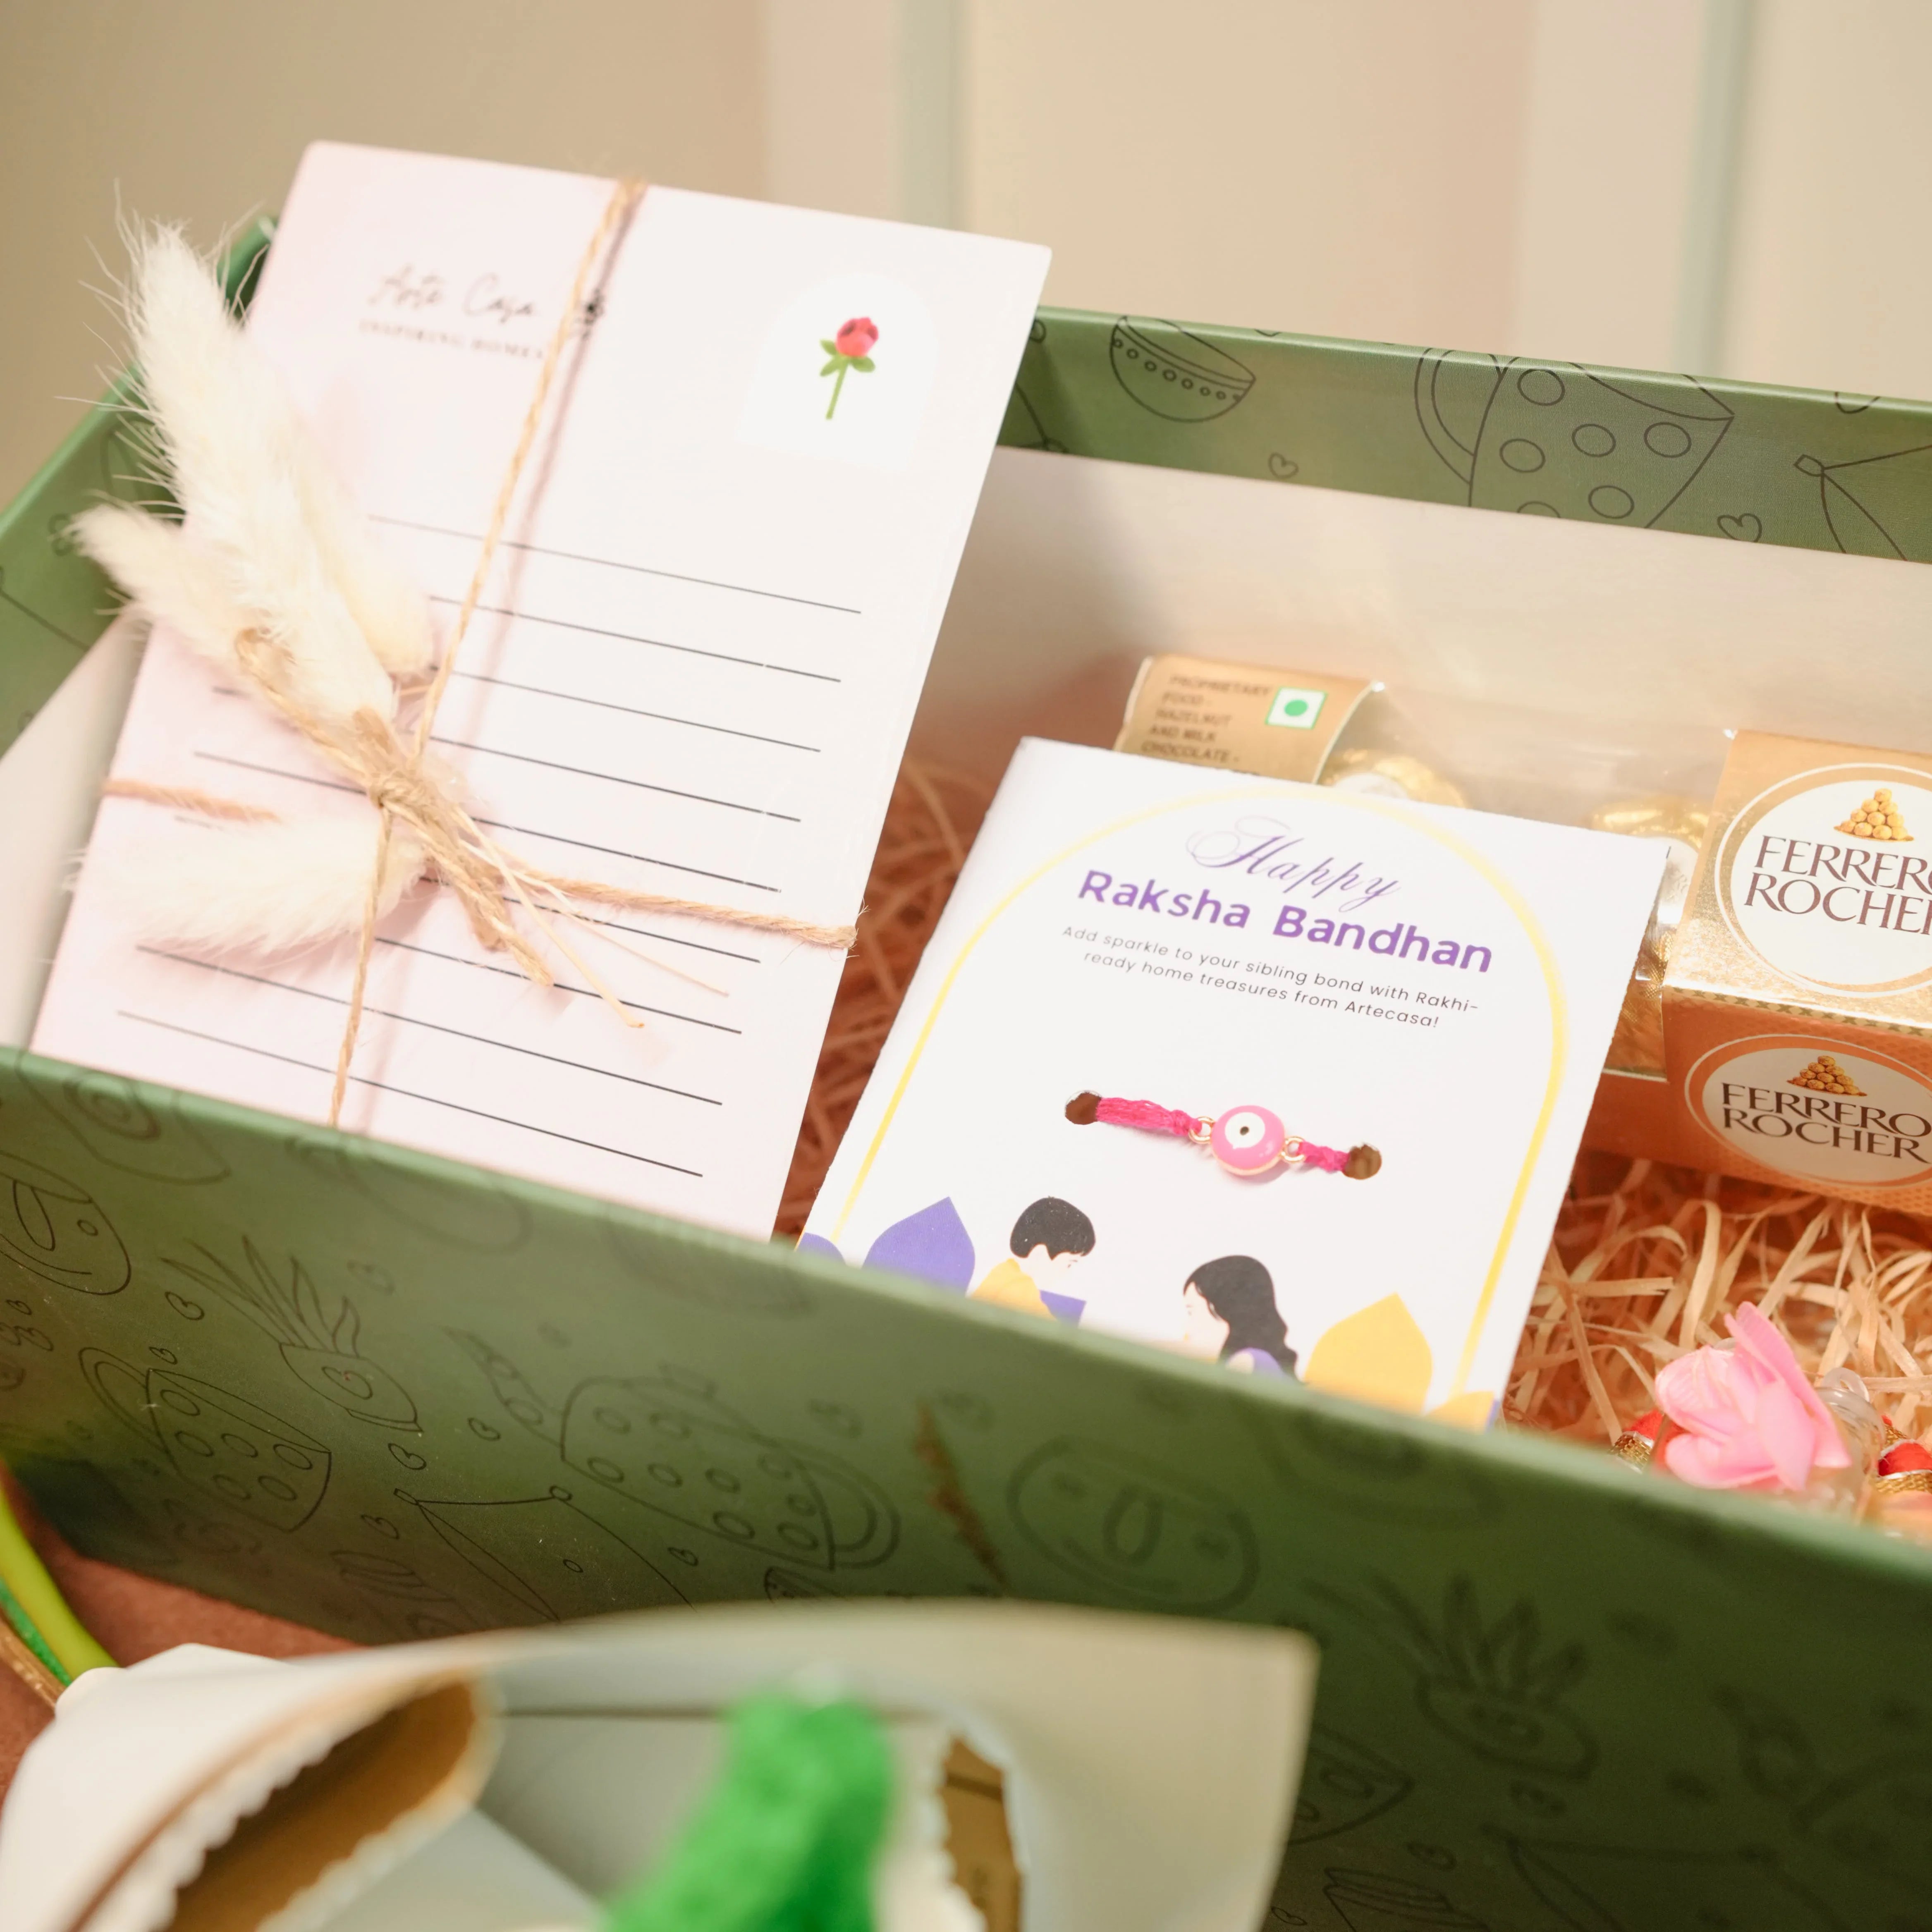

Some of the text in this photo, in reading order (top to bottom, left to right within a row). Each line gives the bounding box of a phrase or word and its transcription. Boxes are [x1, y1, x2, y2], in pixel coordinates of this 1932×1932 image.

[1141, 740, 1231, 763] CHOCOLATE
[1149, 724, 1217, 743] AND MILK
[1186, 815, 1401, 912] Happy
[1754, 835, 1932, 895] FERRER
[1078, 870, 1492, 973] Raksha Bandhan
[1062, 927, 1478, 1012] Add sparkle to your sibling bond with Rakhi-
[1084, 952, 1439, 1028] ready home treasures from Artecasa!
[1721, 1082, 1932, 1137] FERRERO
[1723, 1107, 1932, 1164] ROCHER
